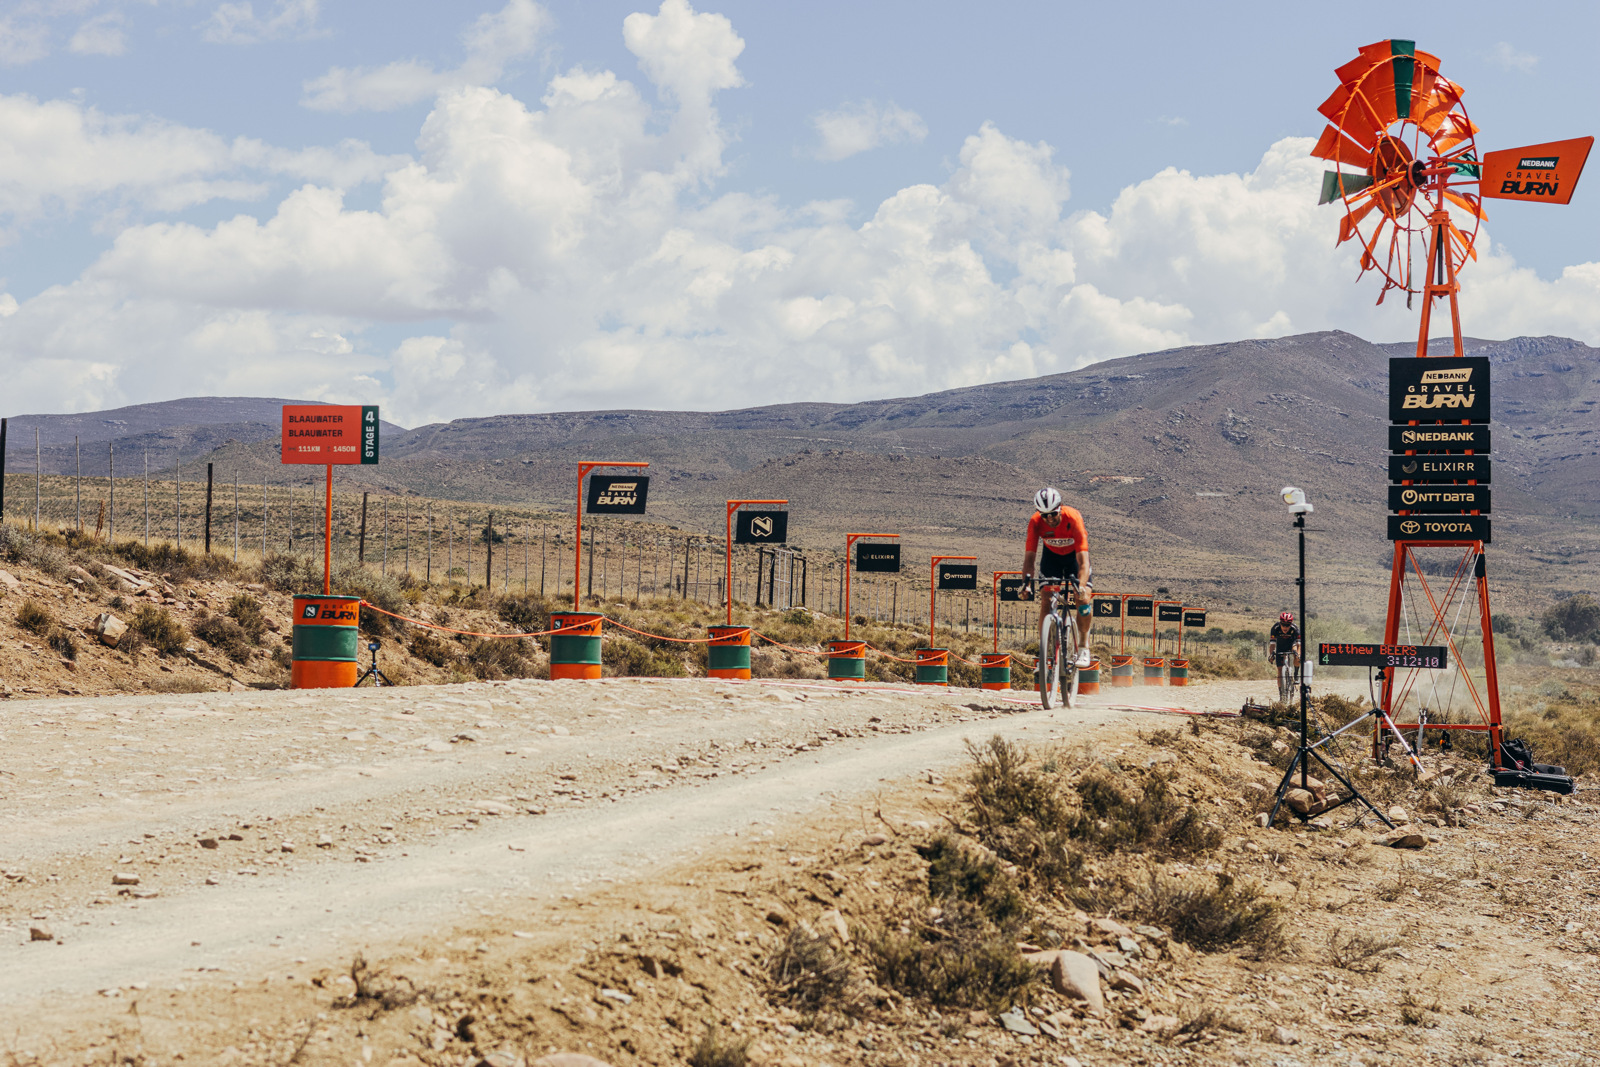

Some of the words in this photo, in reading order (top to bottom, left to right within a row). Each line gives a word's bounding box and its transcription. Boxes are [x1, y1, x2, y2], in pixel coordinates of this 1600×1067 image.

[1506, 172, 1560, 180] GRAVEL
[1500, 180, 1559, 196] BURN
[1408, 384, 1476, 392] GRAVEL
[1402, 394, 1476, 408] BURN
[365, 412, 374, 422] 4
[1416, 432, 1474, 441] NEDBANK
[365, 426, 374, 458] STAGE
[1423, 462, 1474, 472] ELIXIRR
[597, 496, 637, 505] BURN
[1418, 494, 1442, 502] NTT
[1424, 522, 1473, 532] TOYOTA
[320, 610, 356, 620] BURN
[1322, 644, 1373, 654] Matthew
[1380, 645, 1417, 656] BEERS
[1322, 654, 1329, 664] 4
[1387, 656, 1439, 667] 3:12:10
